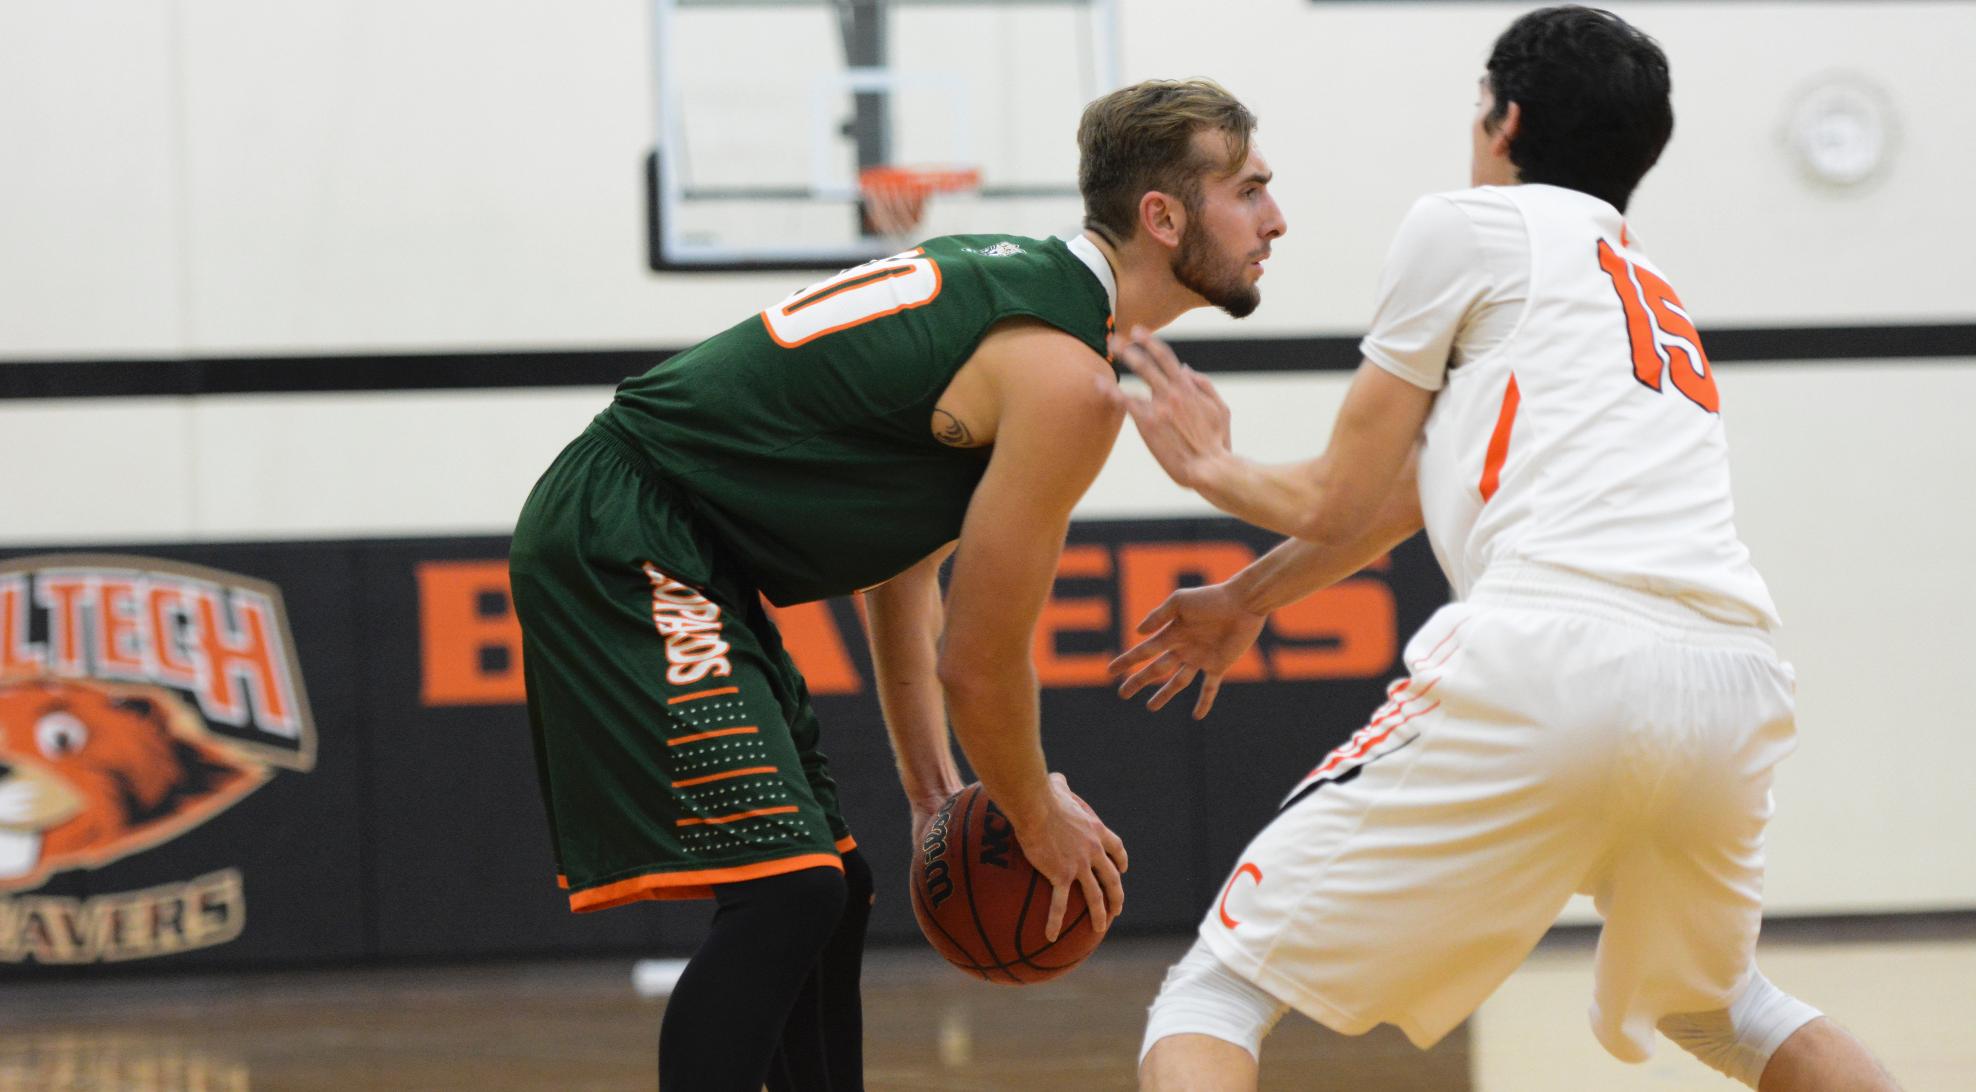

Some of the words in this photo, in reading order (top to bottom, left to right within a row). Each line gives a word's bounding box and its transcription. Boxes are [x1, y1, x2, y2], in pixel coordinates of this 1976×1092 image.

[1597, 237, 1720, 415] 15
[416, 540, 1397, 707] BERS
[1220, 863, 1263, 930] C
